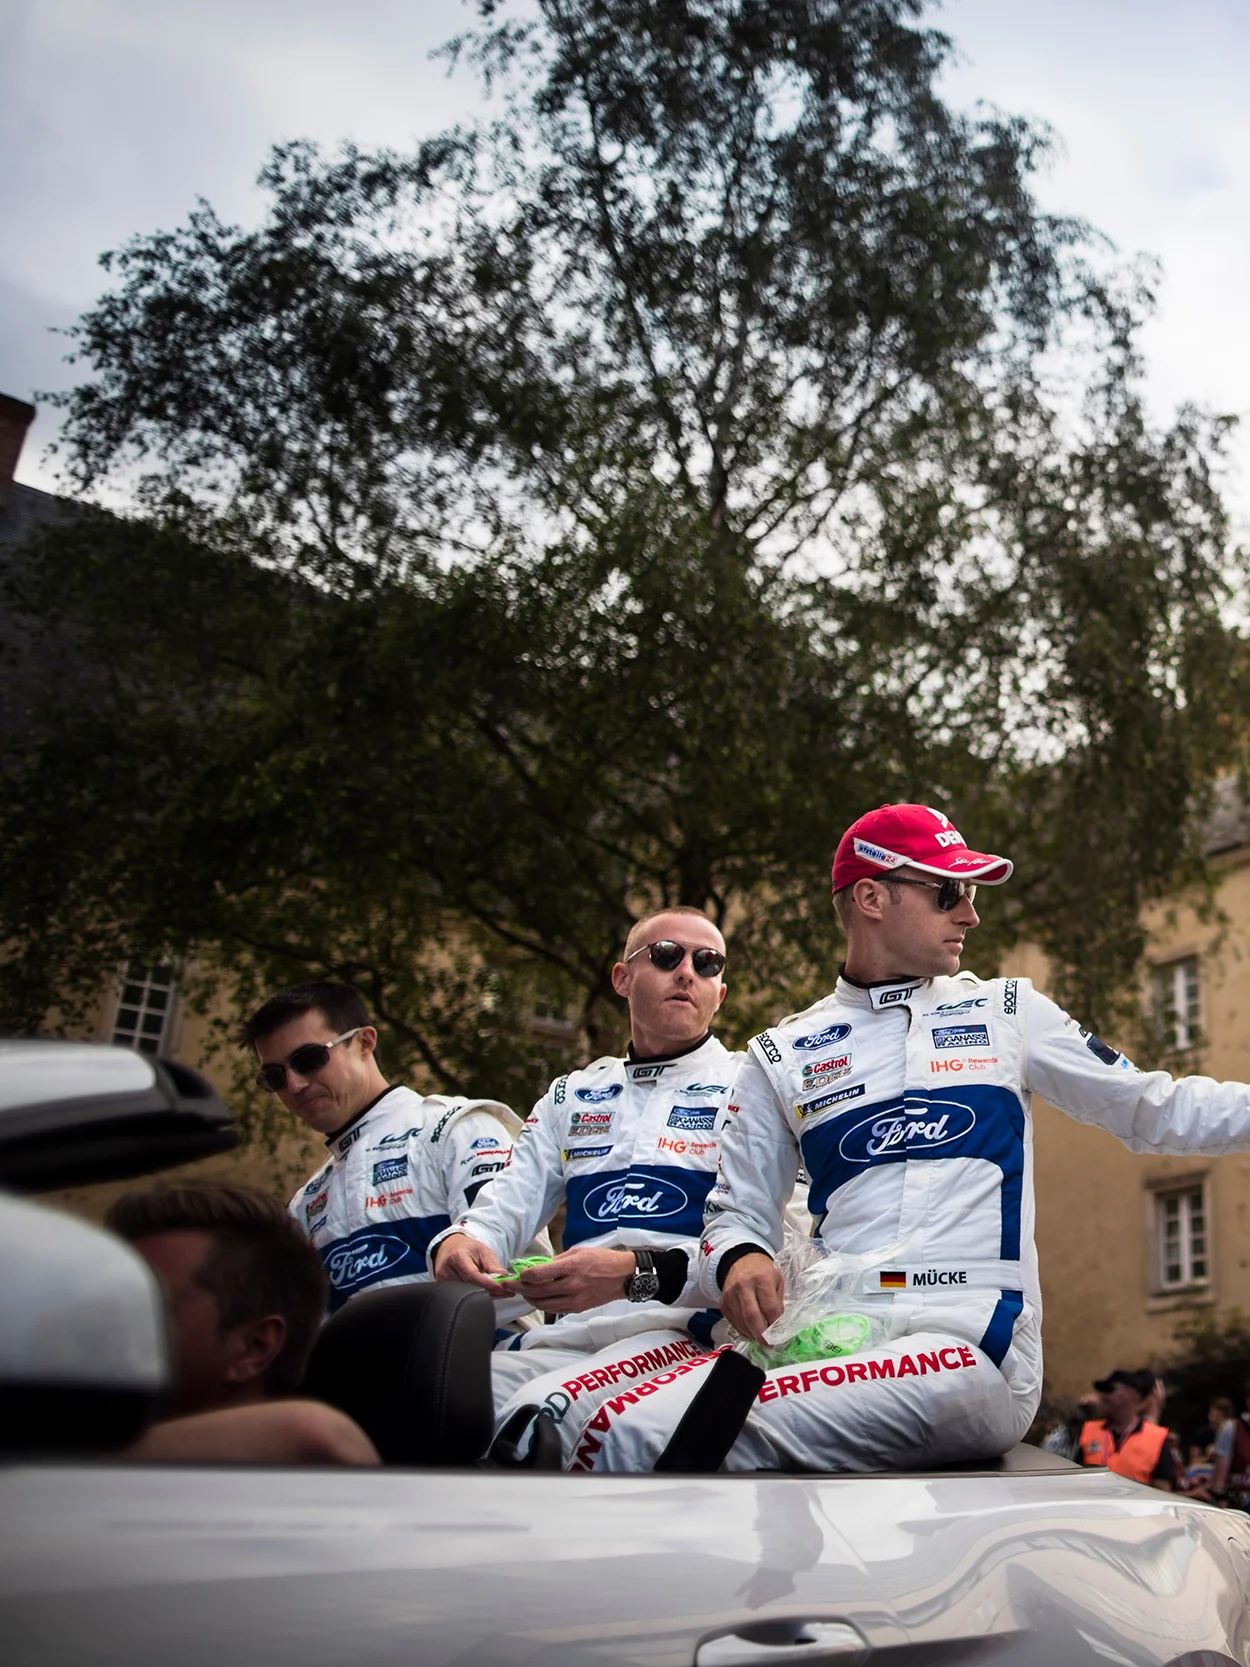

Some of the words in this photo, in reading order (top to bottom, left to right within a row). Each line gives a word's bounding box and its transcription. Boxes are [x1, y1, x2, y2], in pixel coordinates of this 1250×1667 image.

[804, 1028, 841, 1048] Ford
[813, 1056, 848, 1074] Castrol
[930, 1059, 964, 1073] IHG
[814, 1087, 860, 1110] MICHELIN
[581, 1113, 612, 1123] Castrol
[866, 1107, 950, 1156] Ford
[573, 1148, 610, 1157] MICHELIN
[657, 1137, 687, 1154] IHG
[598, 1183, 664, 1217] Ford
[329, 1243, 388, 1286] Ford
[912, 1269, 967, 1287] MÜCKE
[561, 1339, 703, 1401] PERFORMANCE
[758, 1345, 977, 1404] ERFORMANCE
